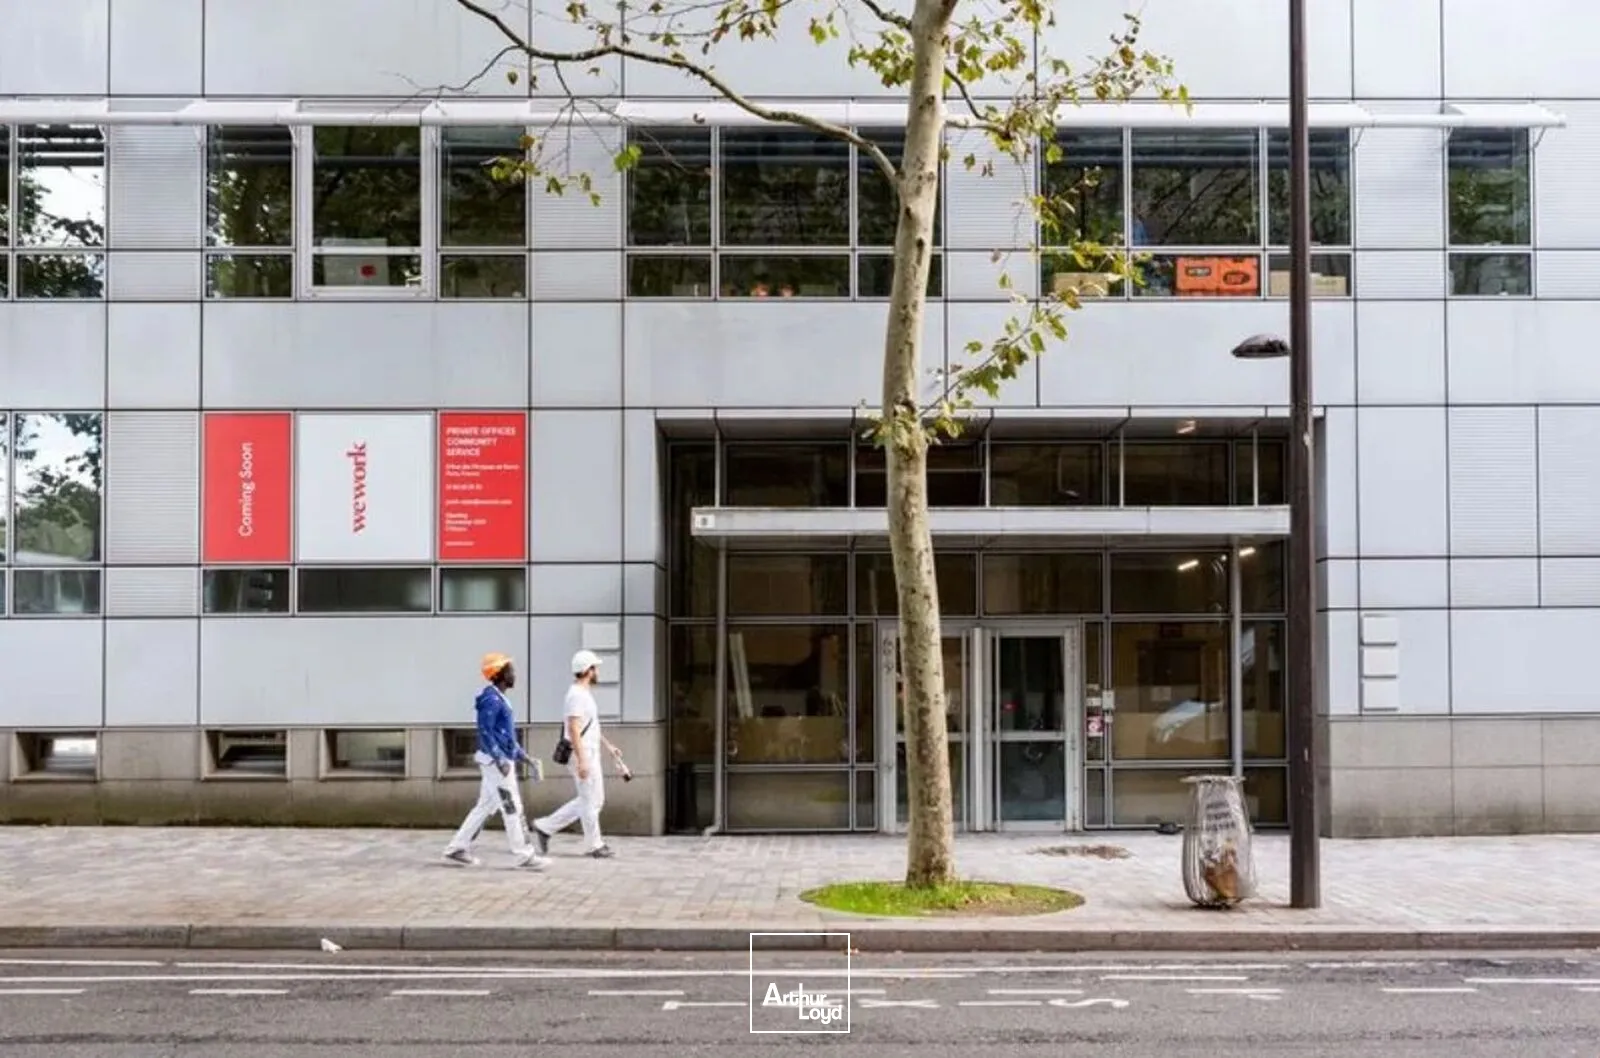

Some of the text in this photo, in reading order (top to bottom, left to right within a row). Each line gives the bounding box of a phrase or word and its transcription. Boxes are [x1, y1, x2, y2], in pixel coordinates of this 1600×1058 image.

[446, 427, 516, 436] PRIVATE OFFICES
[446, 437, 497, 447] COMMUNITY
[446, 448, 480, 456] SERVICE
[238, 442, 255, 537] Coming Soon
[347, 441, 366, 533] wework
